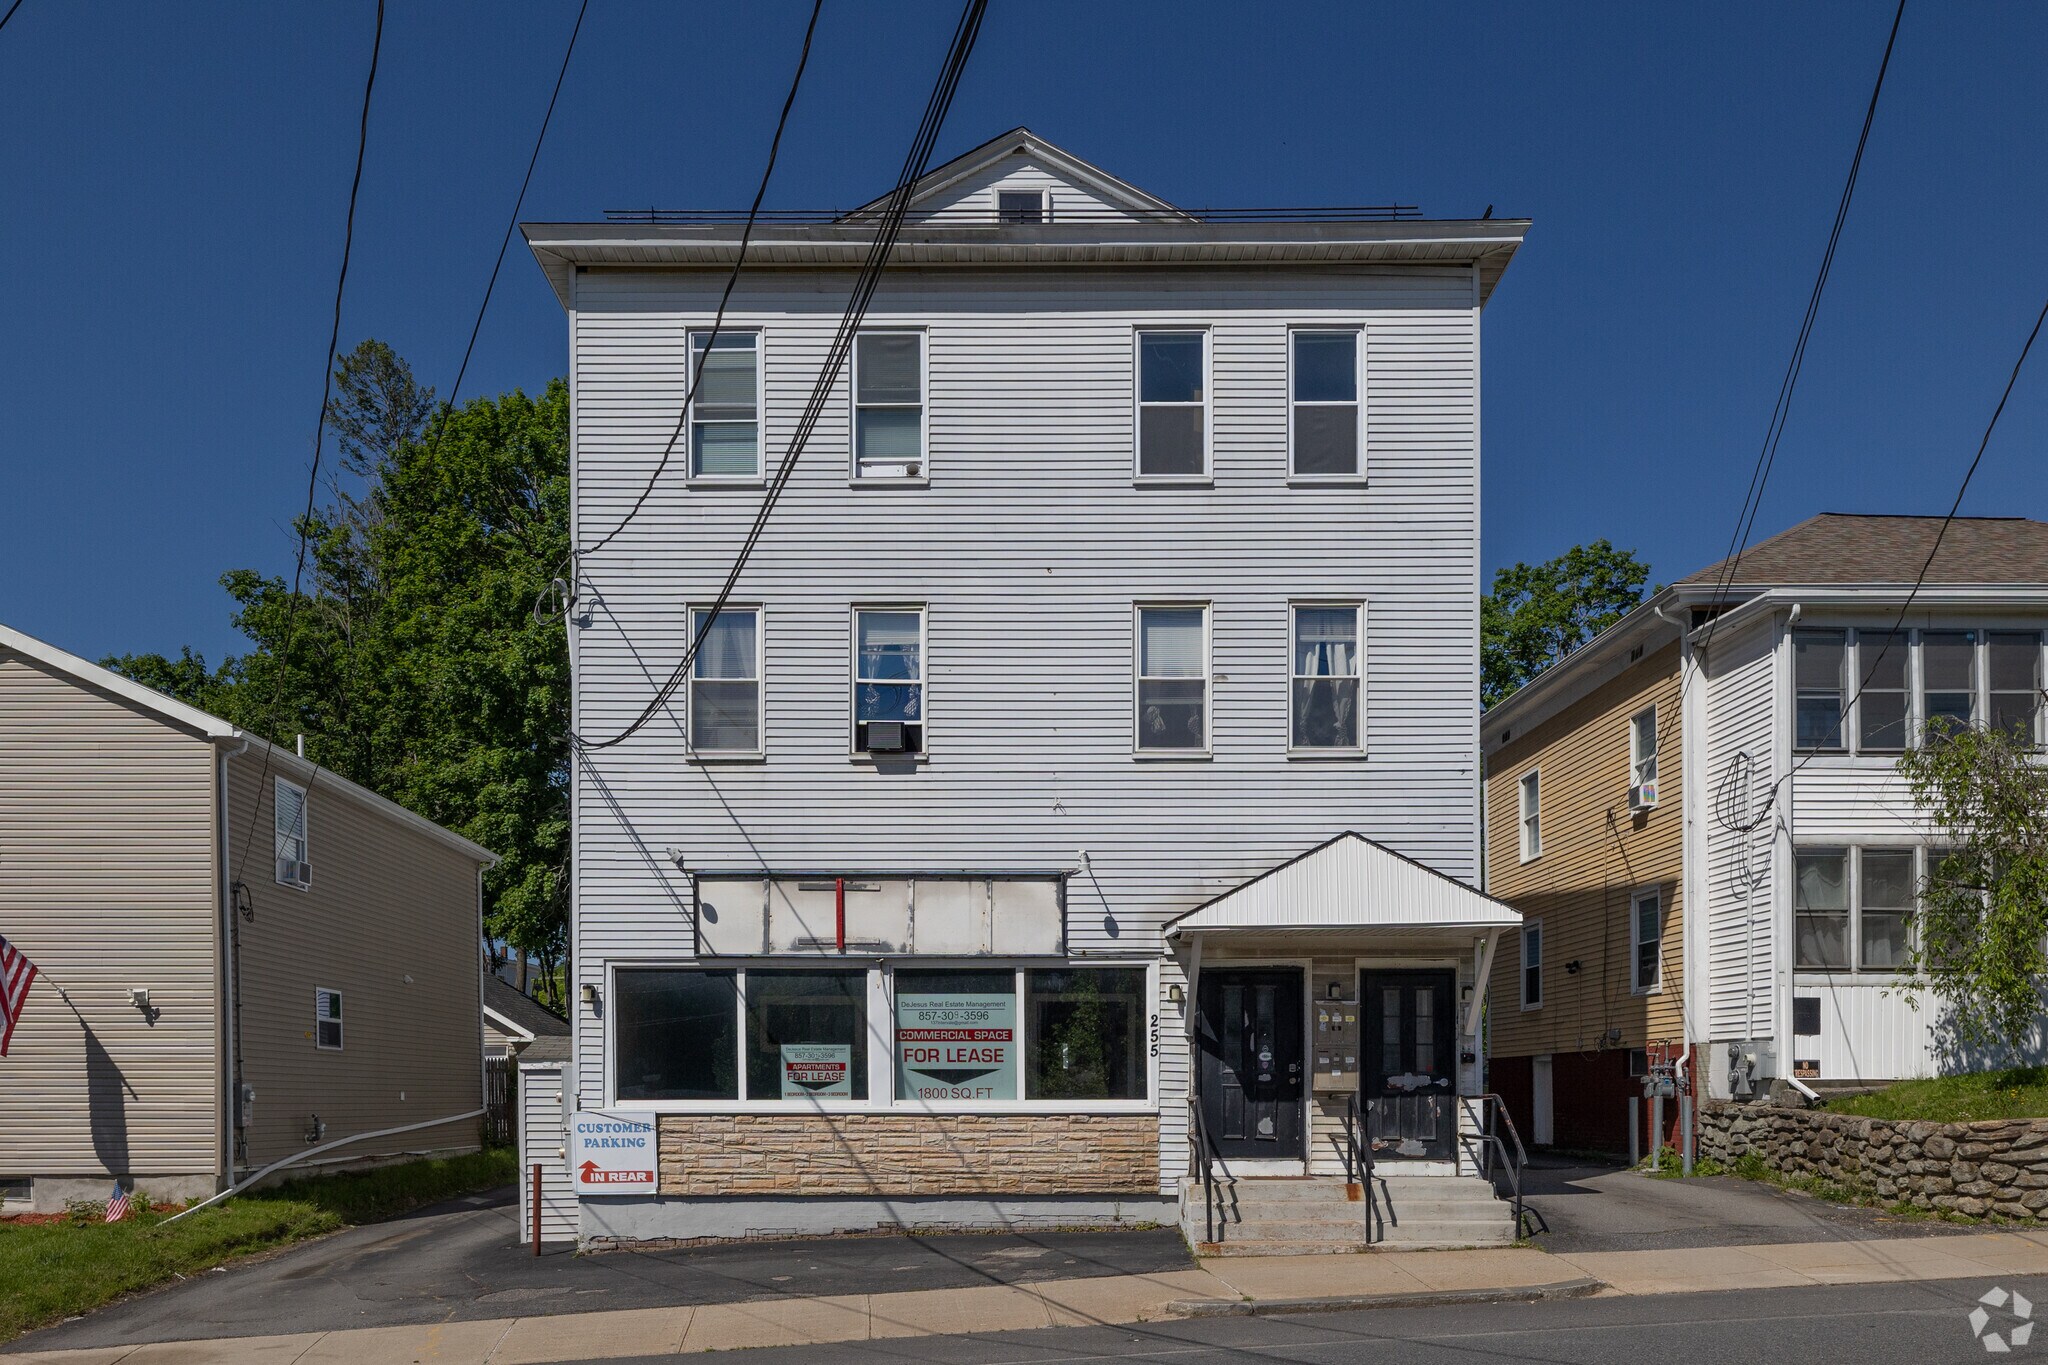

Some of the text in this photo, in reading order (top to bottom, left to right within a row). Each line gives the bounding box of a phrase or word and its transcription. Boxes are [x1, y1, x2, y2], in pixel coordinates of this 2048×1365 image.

[966, 1001, 1006, 1009] Management
[900, 1031, 1009, 1040] COMMERCIAL SPACE
[1150, 1014, 1159, 1057] 255
[904, 1048, 1004, 1063] FOR LEASE
[787, 1072, 845, 1081] FOR LEASE
[918, 1087, 994, 1100] 1800 SQ.FT
[577, 1123, 652, 1134] CUSTOMER
[584, 1137, 646, 1148] PARKING
[590, 1172, 647, 1182] IN REAR
